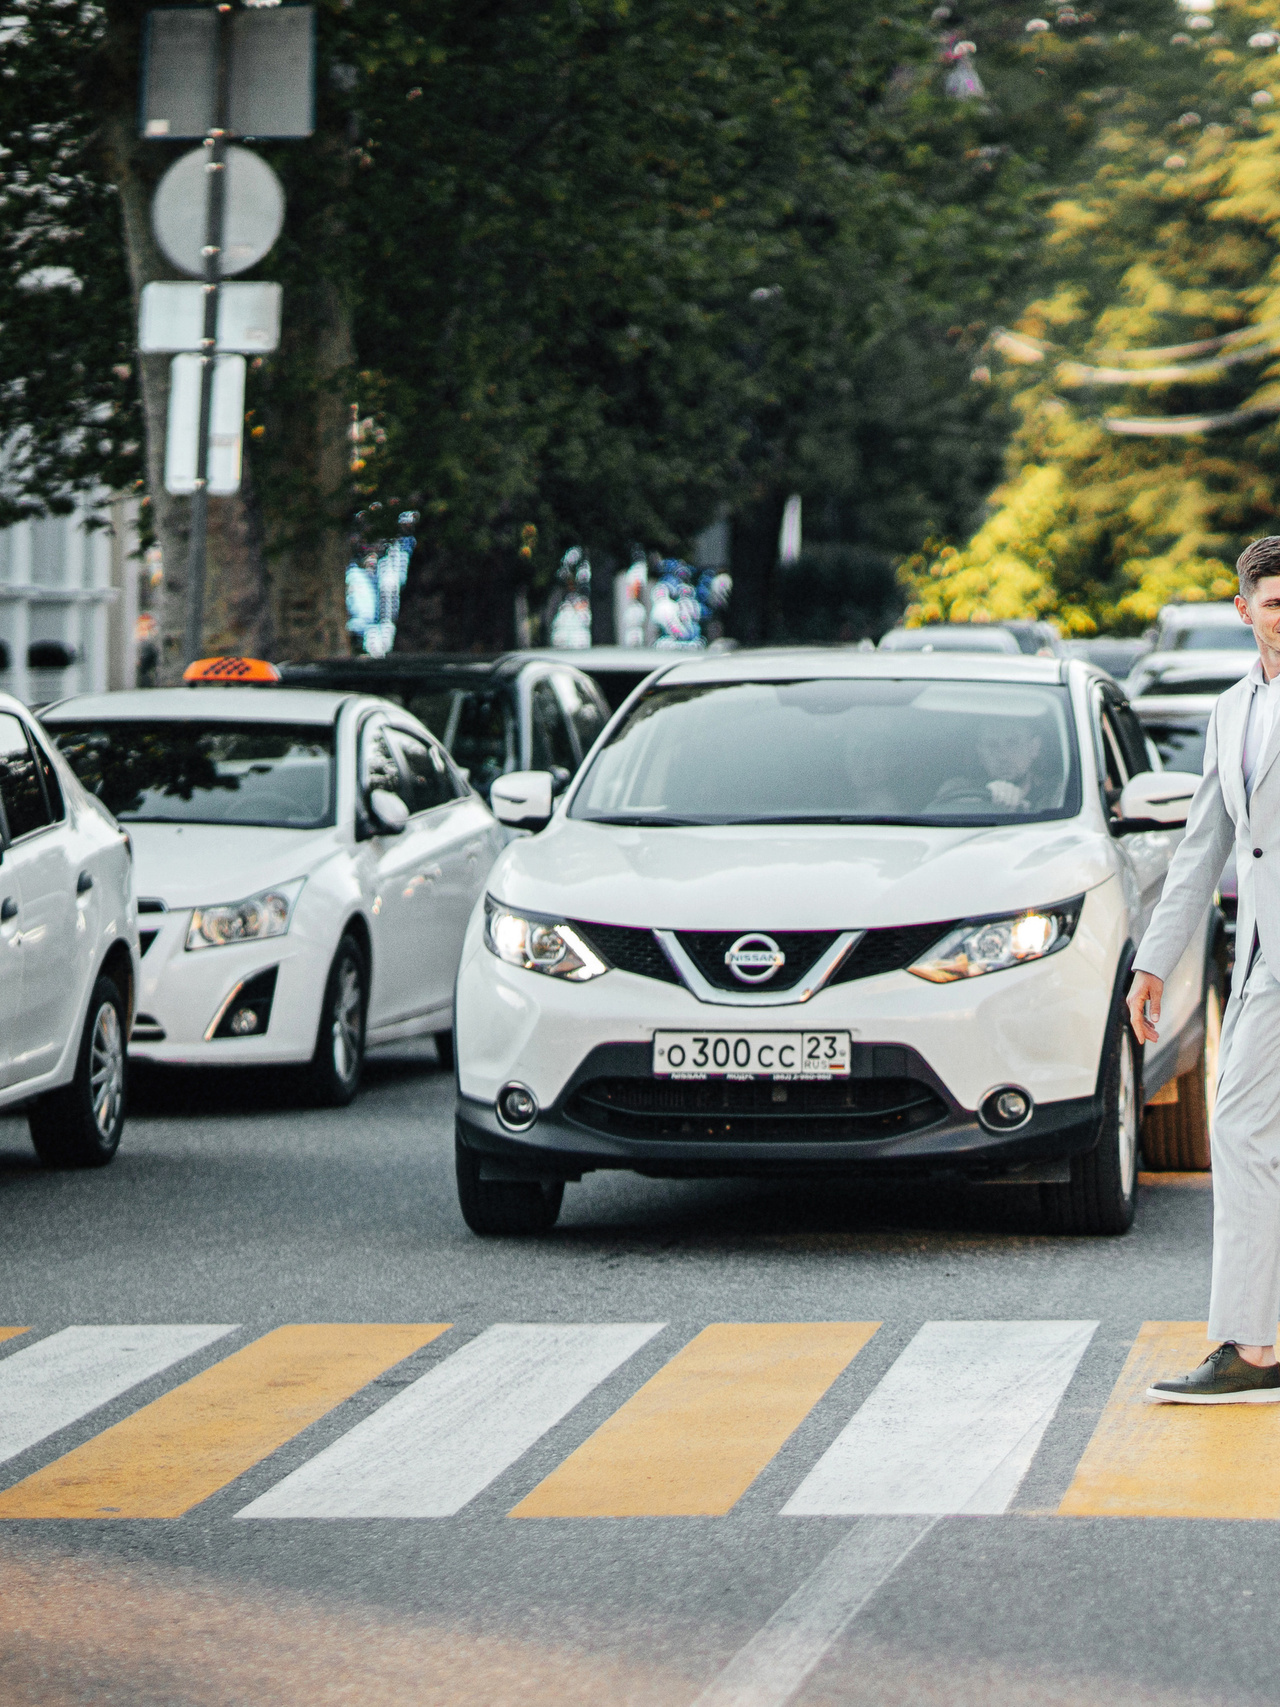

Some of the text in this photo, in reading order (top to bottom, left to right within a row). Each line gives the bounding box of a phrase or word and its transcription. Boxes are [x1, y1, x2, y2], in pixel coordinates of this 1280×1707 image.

[730, 953, 776, 962] NISSAN
[807, 1036, 837, 1059] 23
[804, 1060, 828, 1070] RUS
